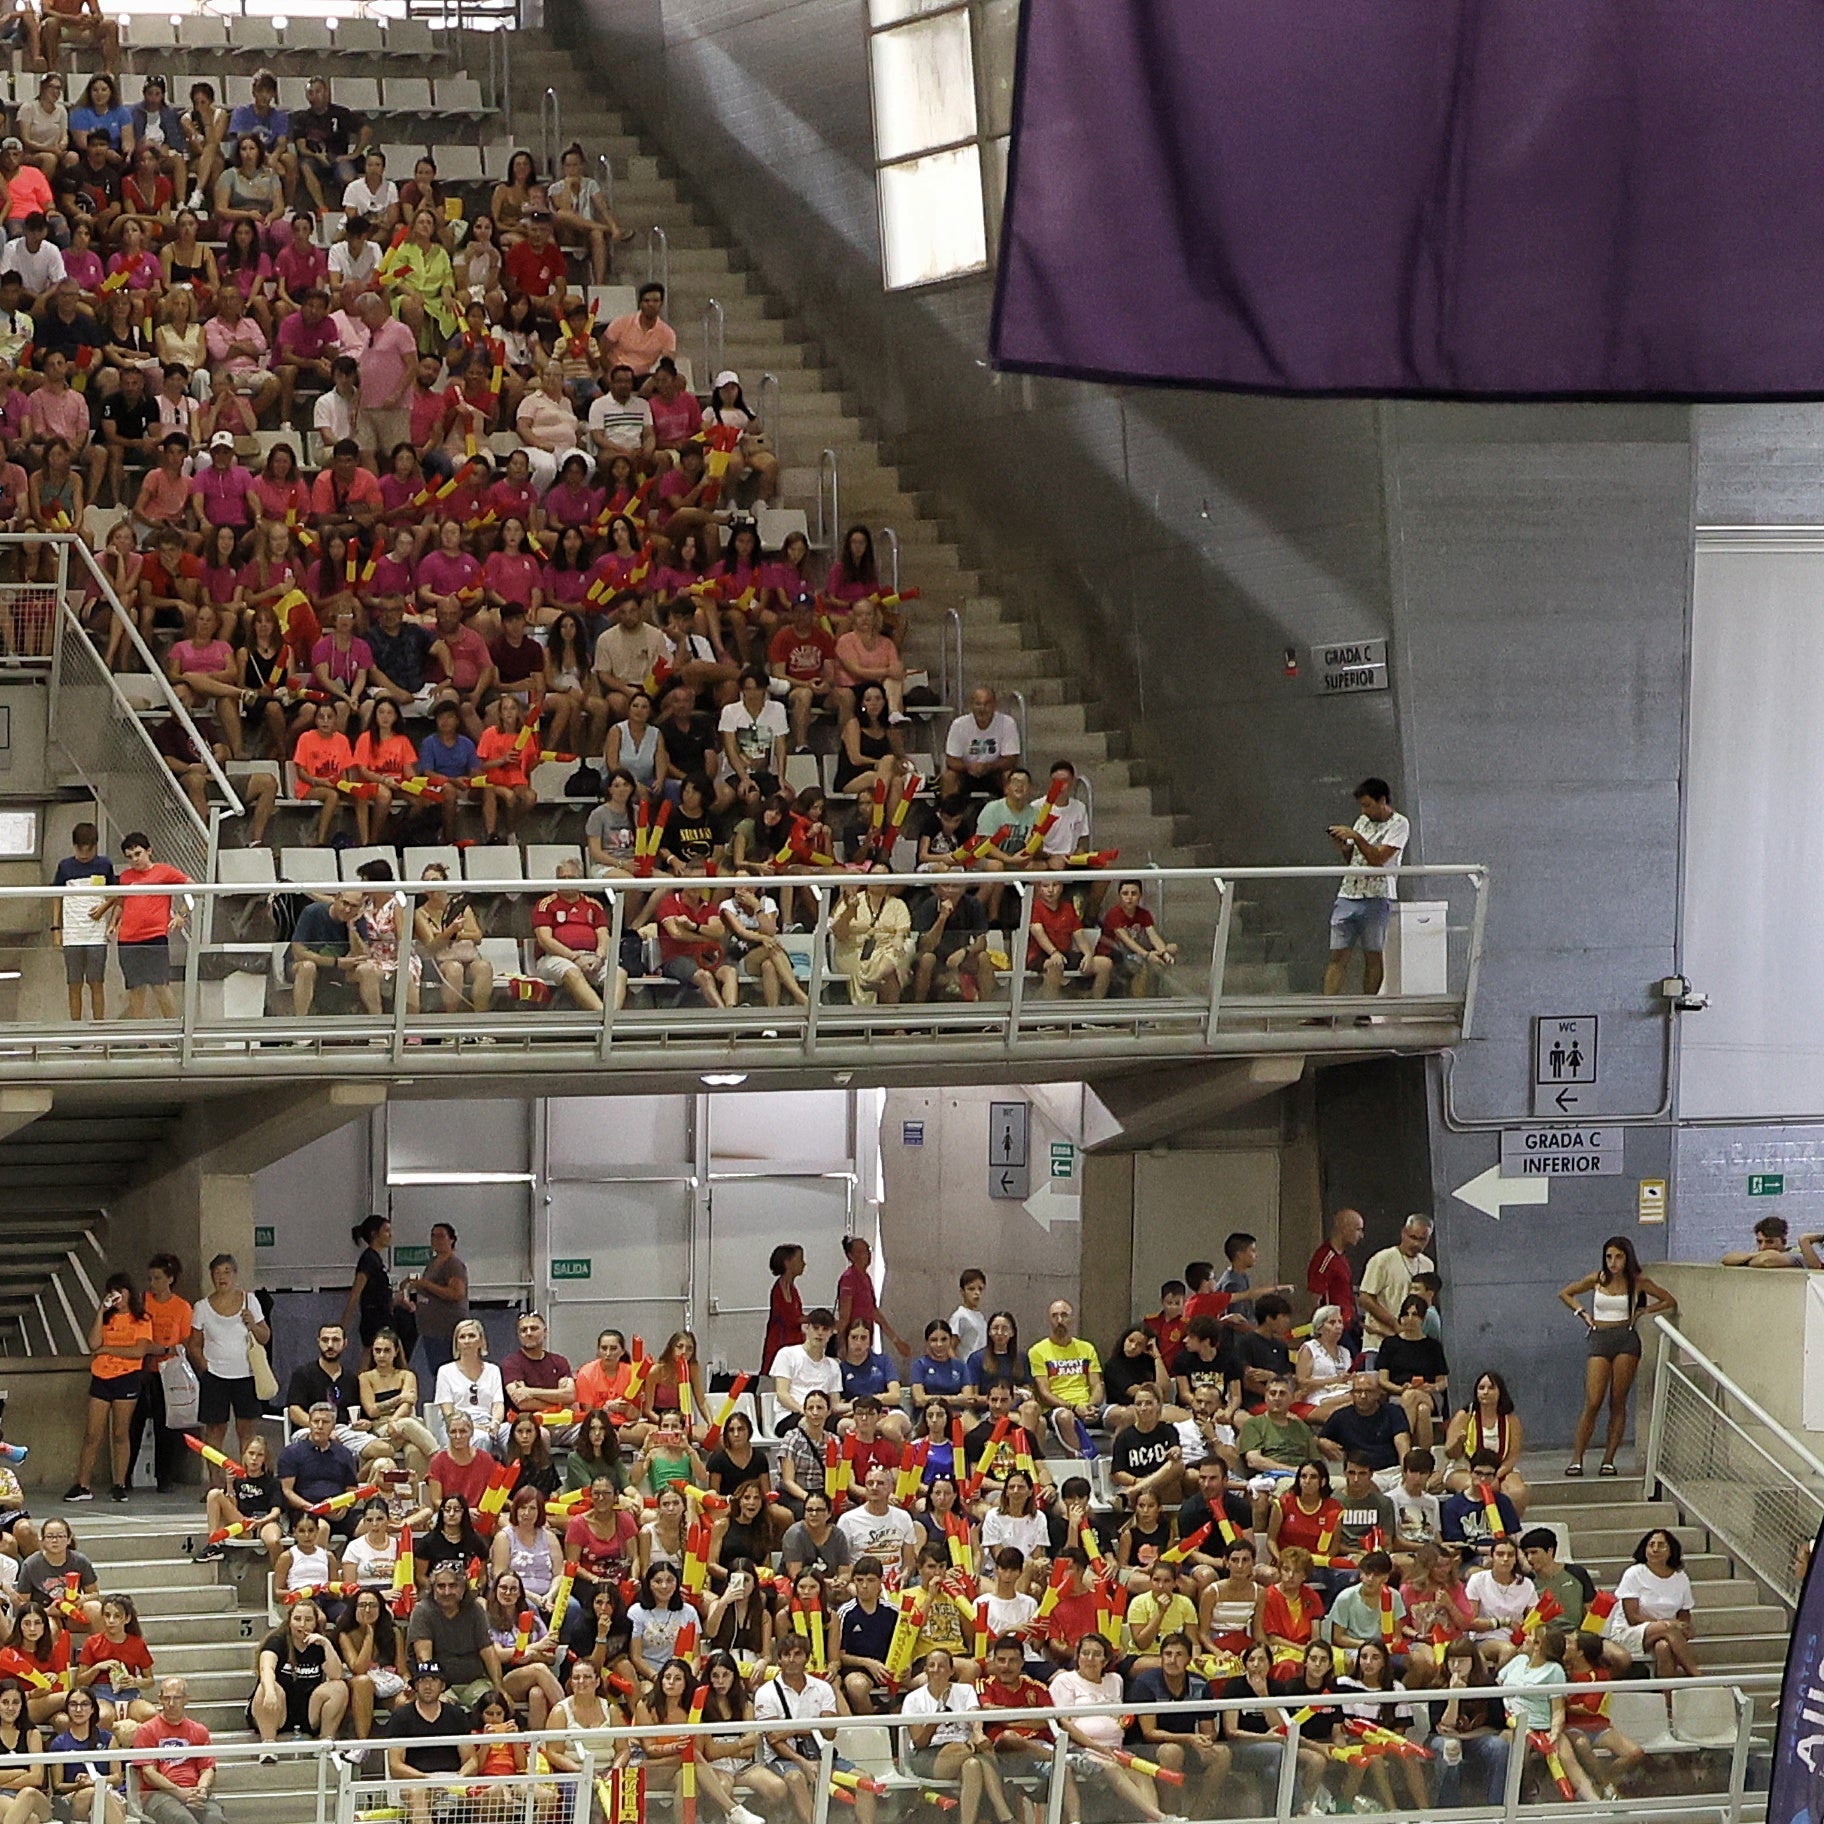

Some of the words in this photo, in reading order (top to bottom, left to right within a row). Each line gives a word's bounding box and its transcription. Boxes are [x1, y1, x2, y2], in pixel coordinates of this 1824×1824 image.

[1325, 647, 1361, 666] GRADA
[1364, 645, 1372, 662] C
[1325, 669, 1375, 690] SUPERIOR
[1559, 1021, 1577, 1033] WC
[1525, 1133, 1585, 1151] GRADA
[1590, 1131, 1601, 1148] C
[1522, 1155, 1600, 1175] INFERIOR
[552, 1262, 590, 1275] SALIDA
[1052, 1358, 1084, 1368] TOMMY
[1057, 1366, 1083, 1376] JEANS
[1342, 1509, 1378, 1526] UMA
[181, 1535, 194, 1554] 4
[240, 1619, 253, 1638] 3
